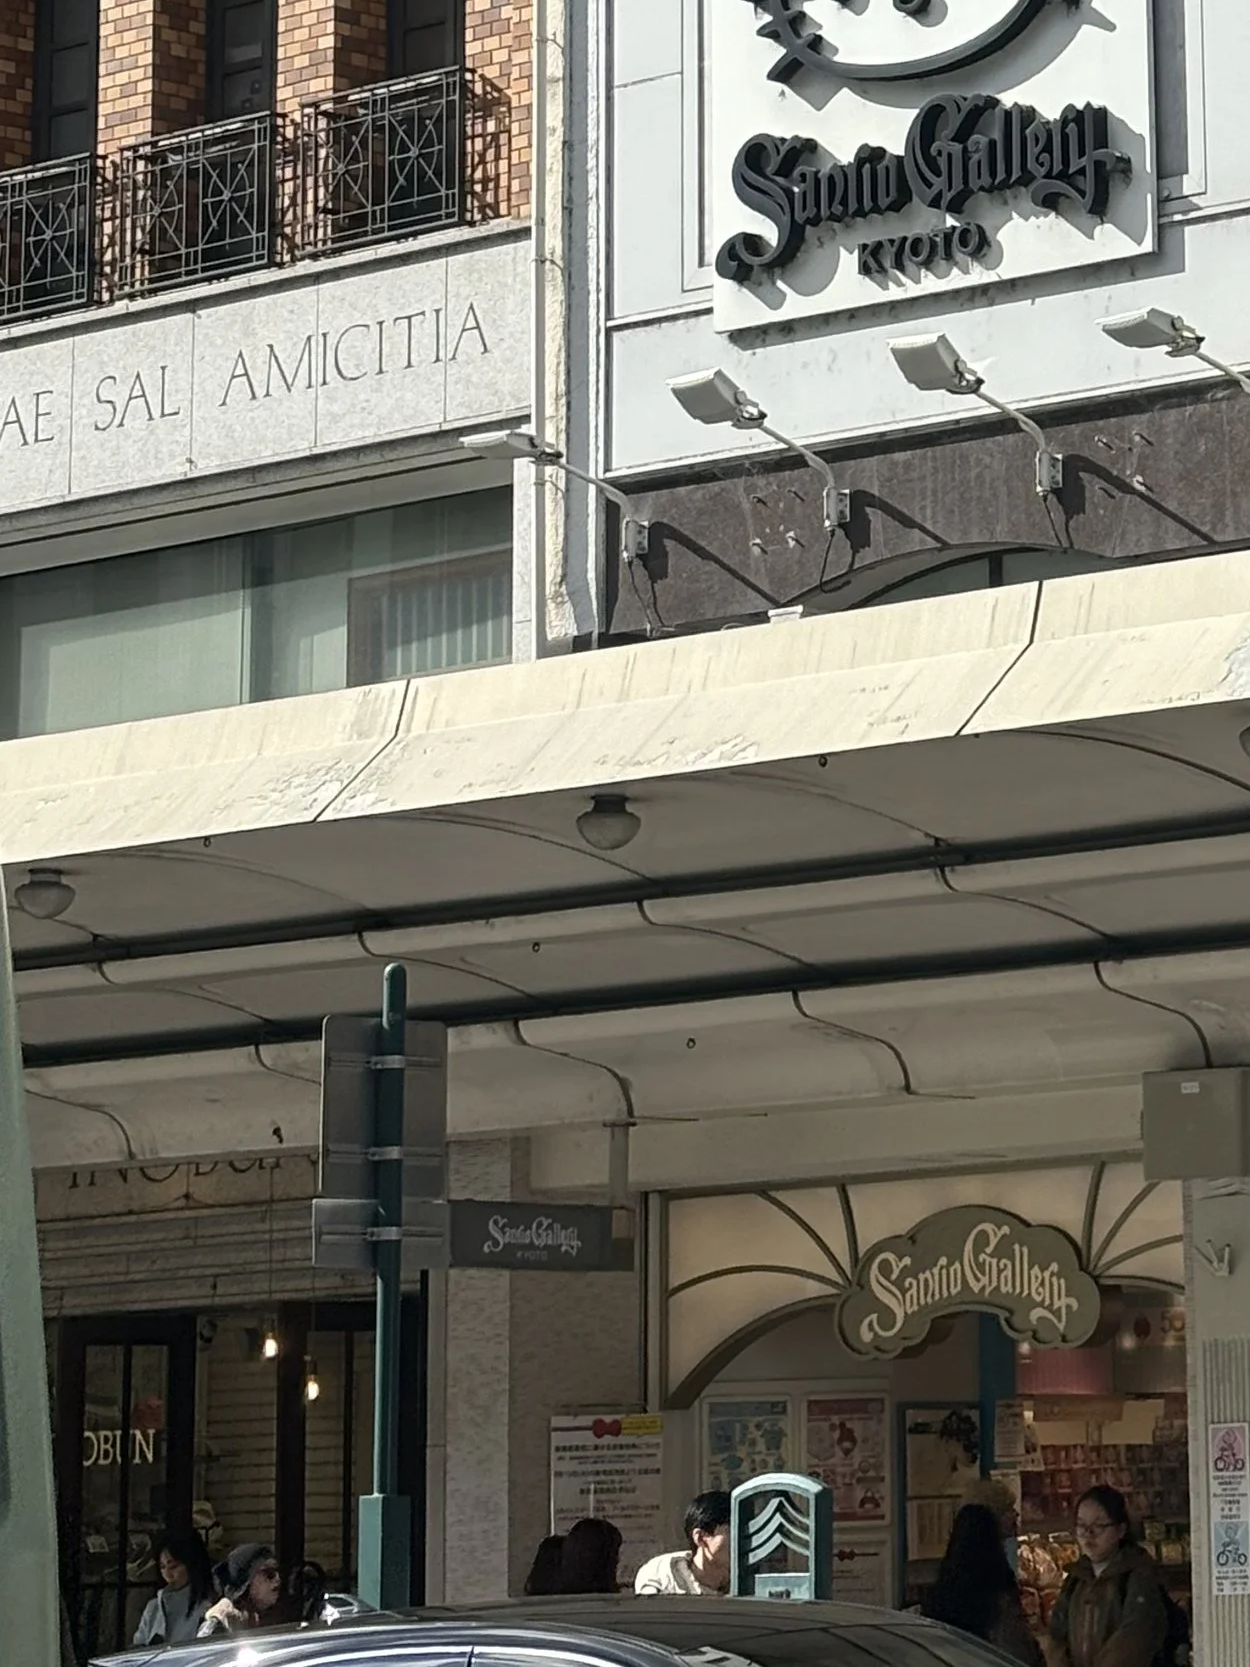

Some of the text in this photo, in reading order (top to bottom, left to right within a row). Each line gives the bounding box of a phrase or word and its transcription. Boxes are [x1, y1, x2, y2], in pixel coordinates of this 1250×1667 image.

[715, 93, 1132, 281] Sanrio Gallery
[857, 222, 991, 275] KYOTO
[94, 365, 180, 432] SAL
[218, 302, 491, 407] AMICITIA
[860, 1222, 1078, 1342] Sanrio Gallery
